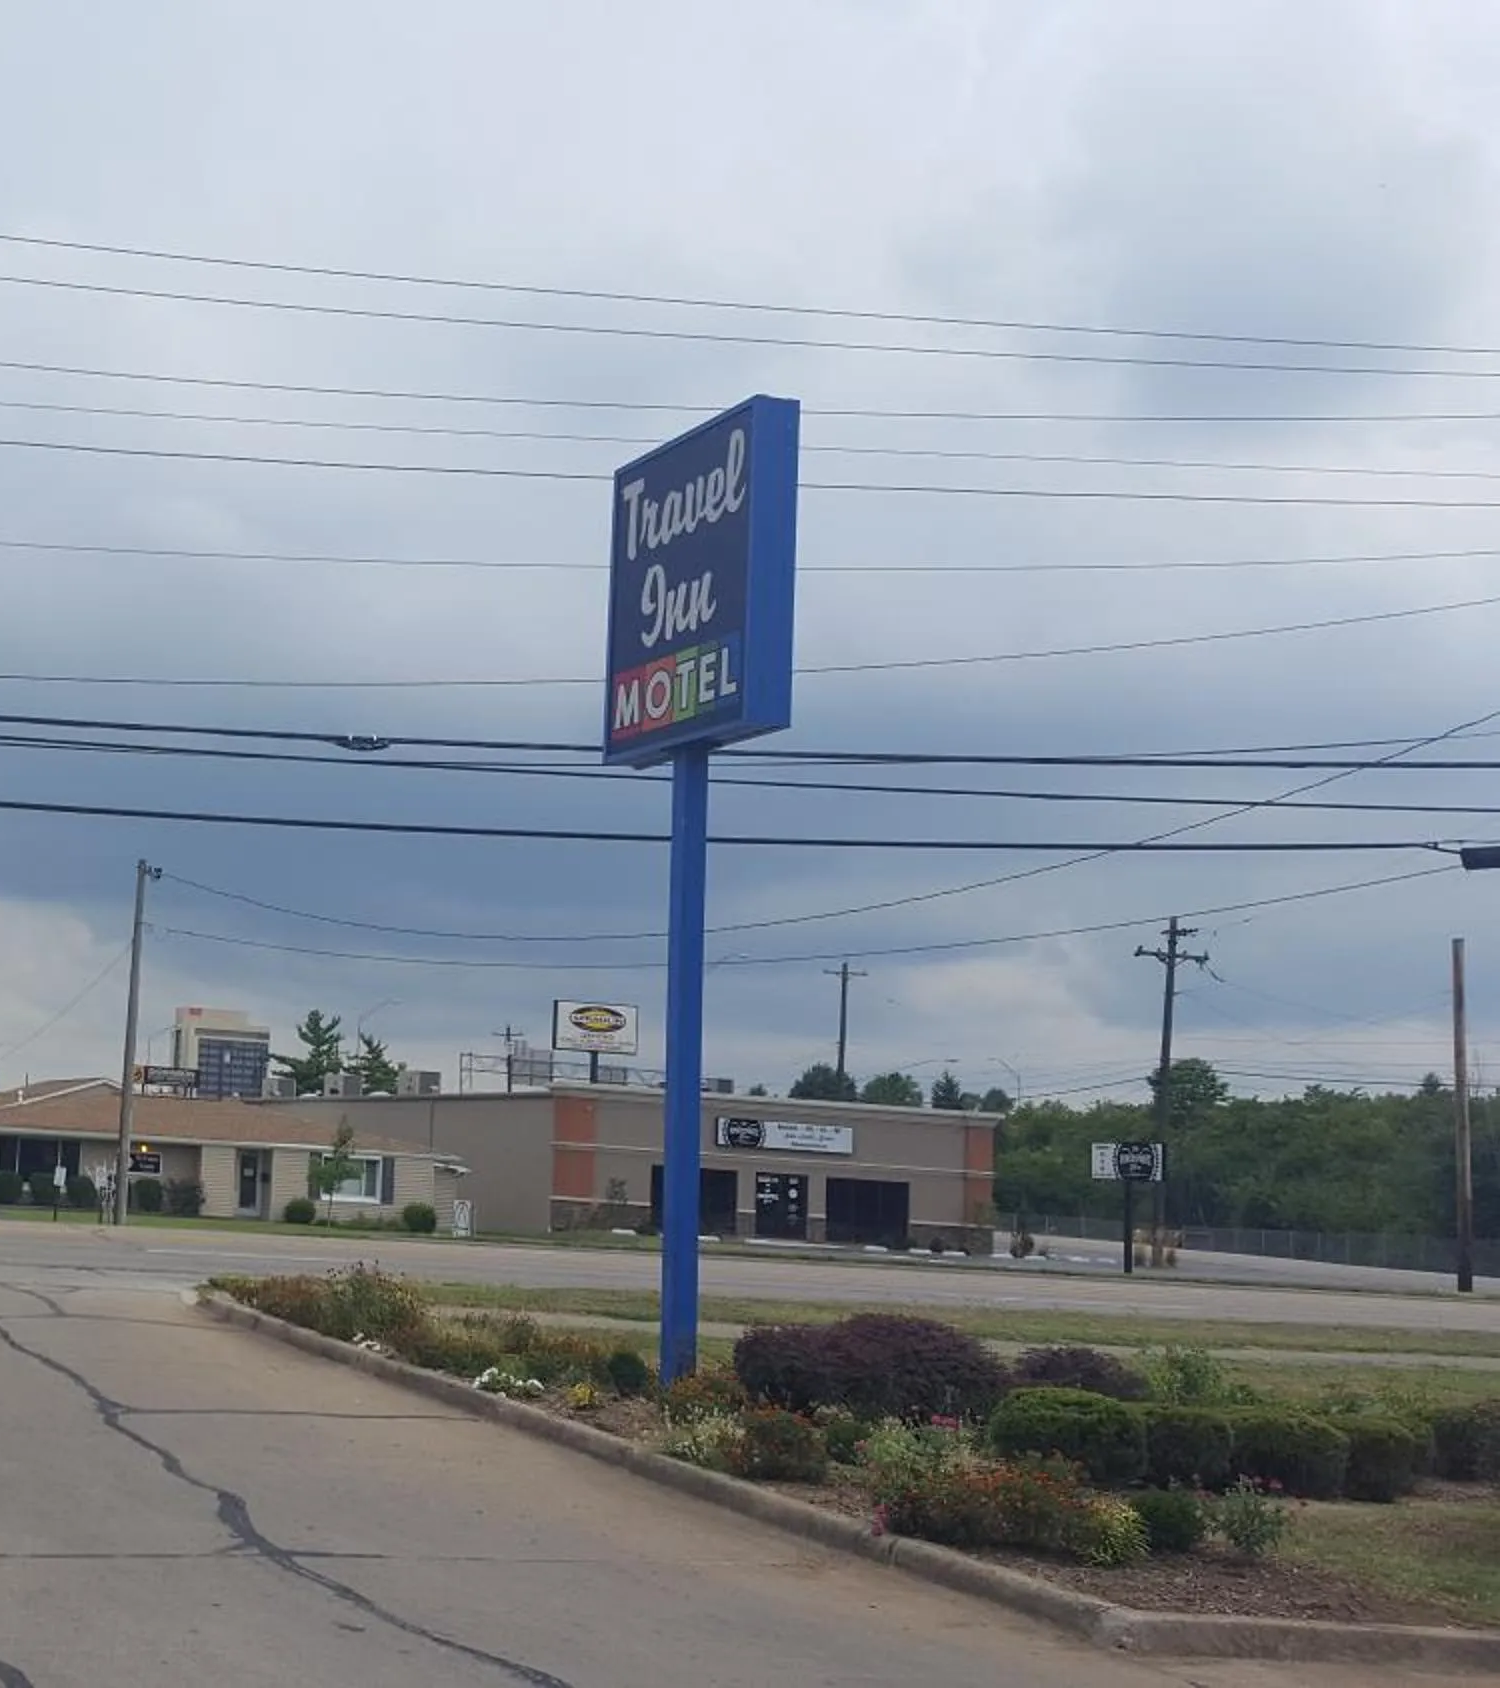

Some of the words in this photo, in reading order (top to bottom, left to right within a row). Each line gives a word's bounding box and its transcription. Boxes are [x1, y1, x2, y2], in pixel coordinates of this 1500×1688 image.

[621, 428, 746, 561] Travel
[640, 564, 717, 648] Inn
[613, 647, 737, 730] MOTEL
